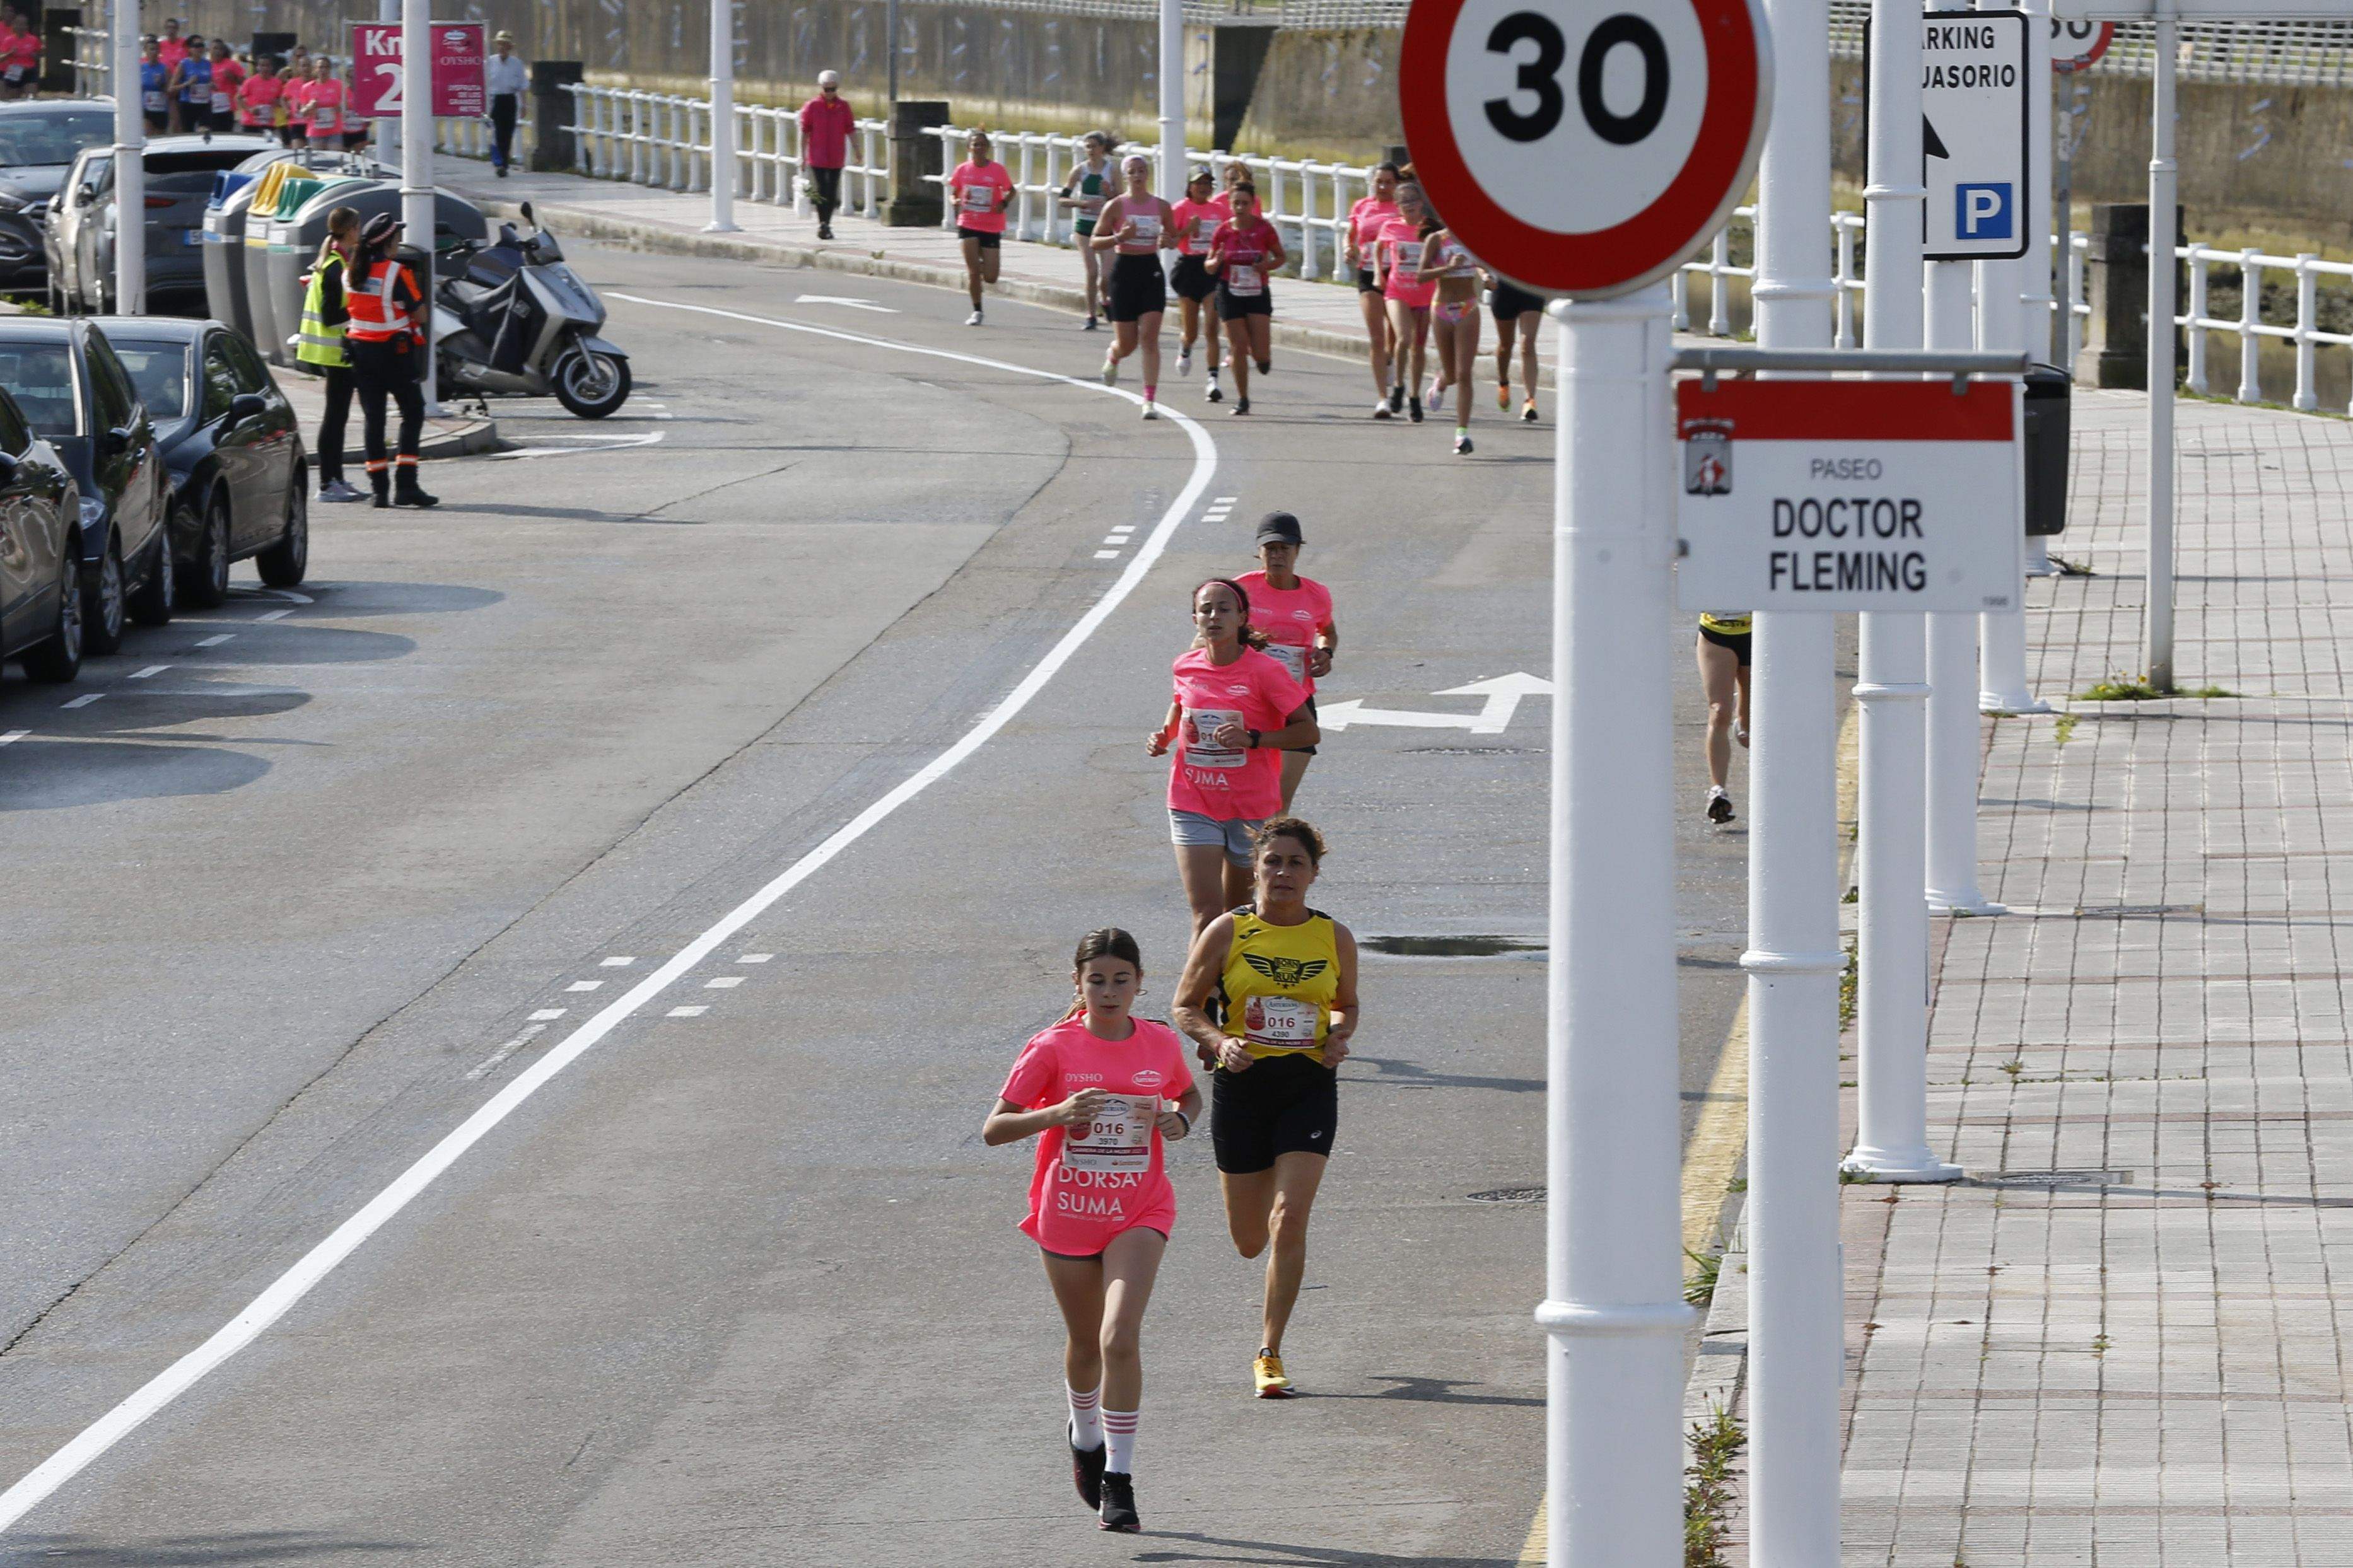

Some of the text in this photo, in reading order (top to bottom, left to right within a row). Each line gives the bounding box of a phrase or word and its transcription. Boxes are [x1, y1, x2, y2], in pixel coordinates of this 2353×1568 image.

[1922, 26, 1995, 50] RKING
[374, 62, 402, 110] 2
[1484, 11, 1669, 146] 30
[1966, 189, 2002, 233] P
[1811, 458, 1882, 480] PASEO
[1772, 498, 1924, 539] DOCTOR
[1769, 551, 1926, 592] FLEMING
[1276, 972, 1298, 982] RUN
[1268, 1017, 1295, 1028] 016
[1065, 1073, 1103, 1082] OYSHO
[1094, 1122, 1124, 1134] 016
[1099, 1137, 1118, 1146] 3970
[1057, 1191, 1123, 1216] SUMA
